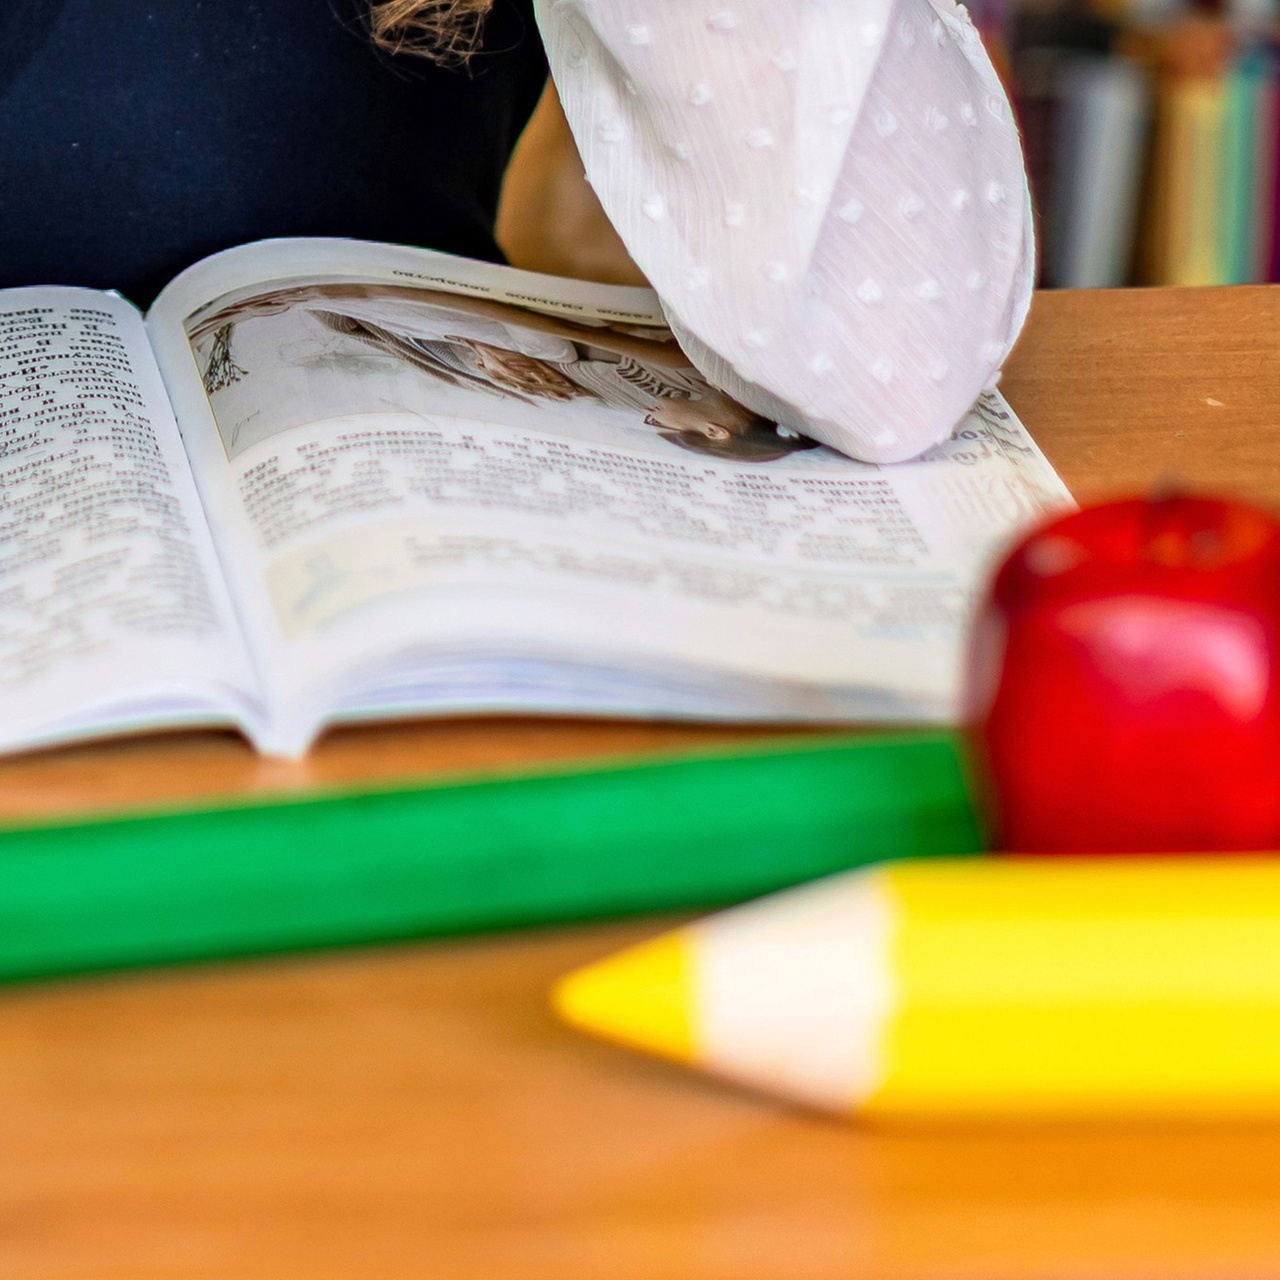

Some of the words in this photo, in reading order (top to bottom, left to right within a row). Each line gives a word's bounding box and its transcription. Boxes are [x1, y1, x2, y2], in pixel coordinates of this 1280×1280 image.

[391, 270, 490, 293] лекарство
[504, 292, 584, 311] сильное
[596, 308, 653, 320] самое
[69, 346, 128, 357] слова
[17, 353, 130, 366] поступали
[73, 362, 133, 373] нами:
[25, 369, 115, 382] Христос
[58, 377, 139, 388] лованы
[20, 389, 57, 401] что
[76, 395, 146, 407] такою
[34, 410, 107, 426] сейчас
[60, 419, 155, 432] тельную
